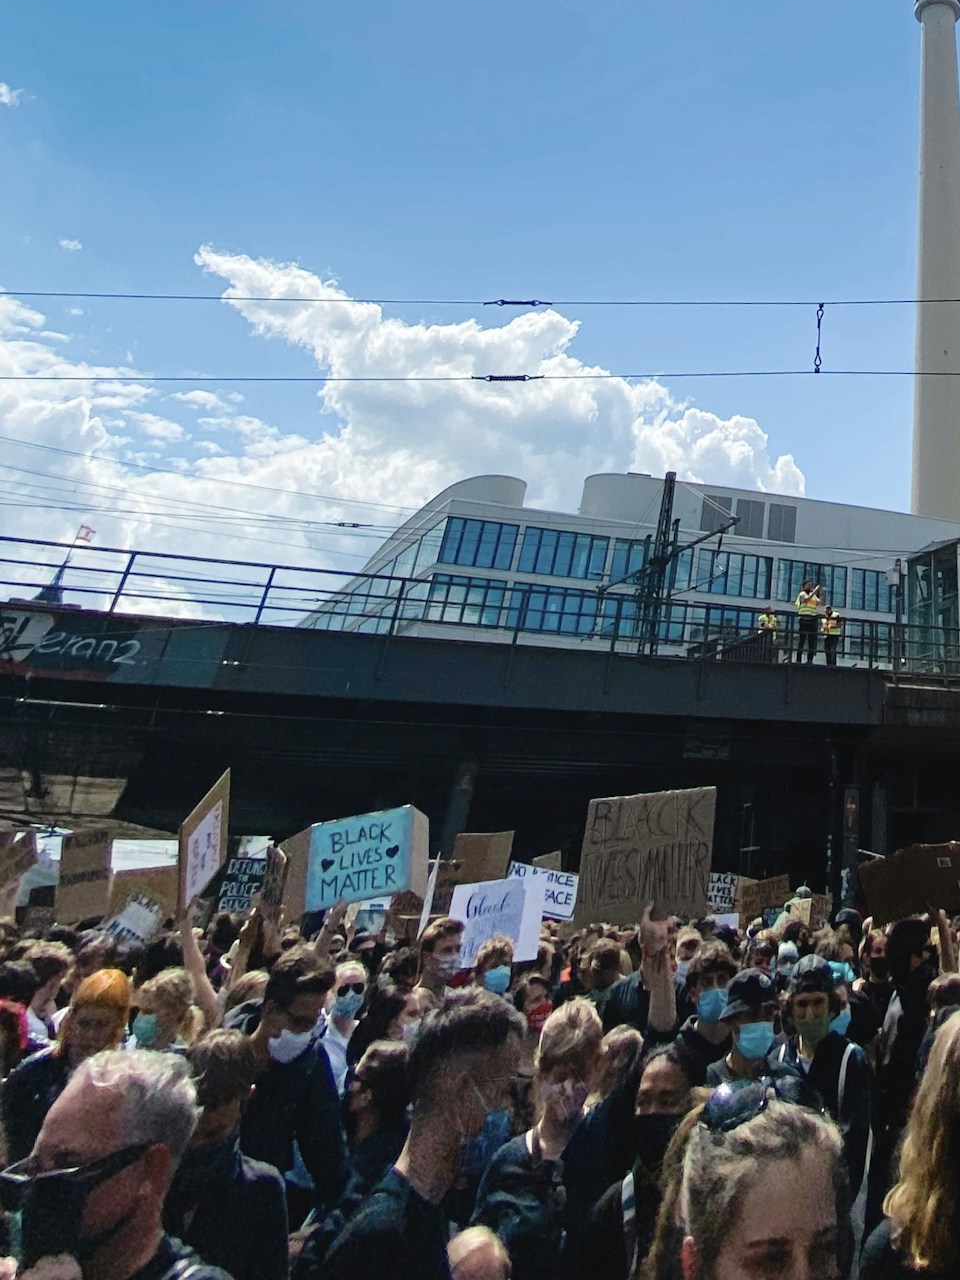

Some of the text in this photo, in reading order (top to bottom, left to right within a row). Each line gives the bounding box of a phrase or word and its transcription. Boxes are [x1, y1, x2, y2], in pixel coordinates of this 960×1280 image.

[329, 822, 393, 854] BLACK
[339, 847, 383, 870] LIVES
[510, 864, 526, 878] NO
[219, 881, 261, 897] POLICE
[321, 864, 396, 901] MATTER
[711, 875, 737, 887] LACK
